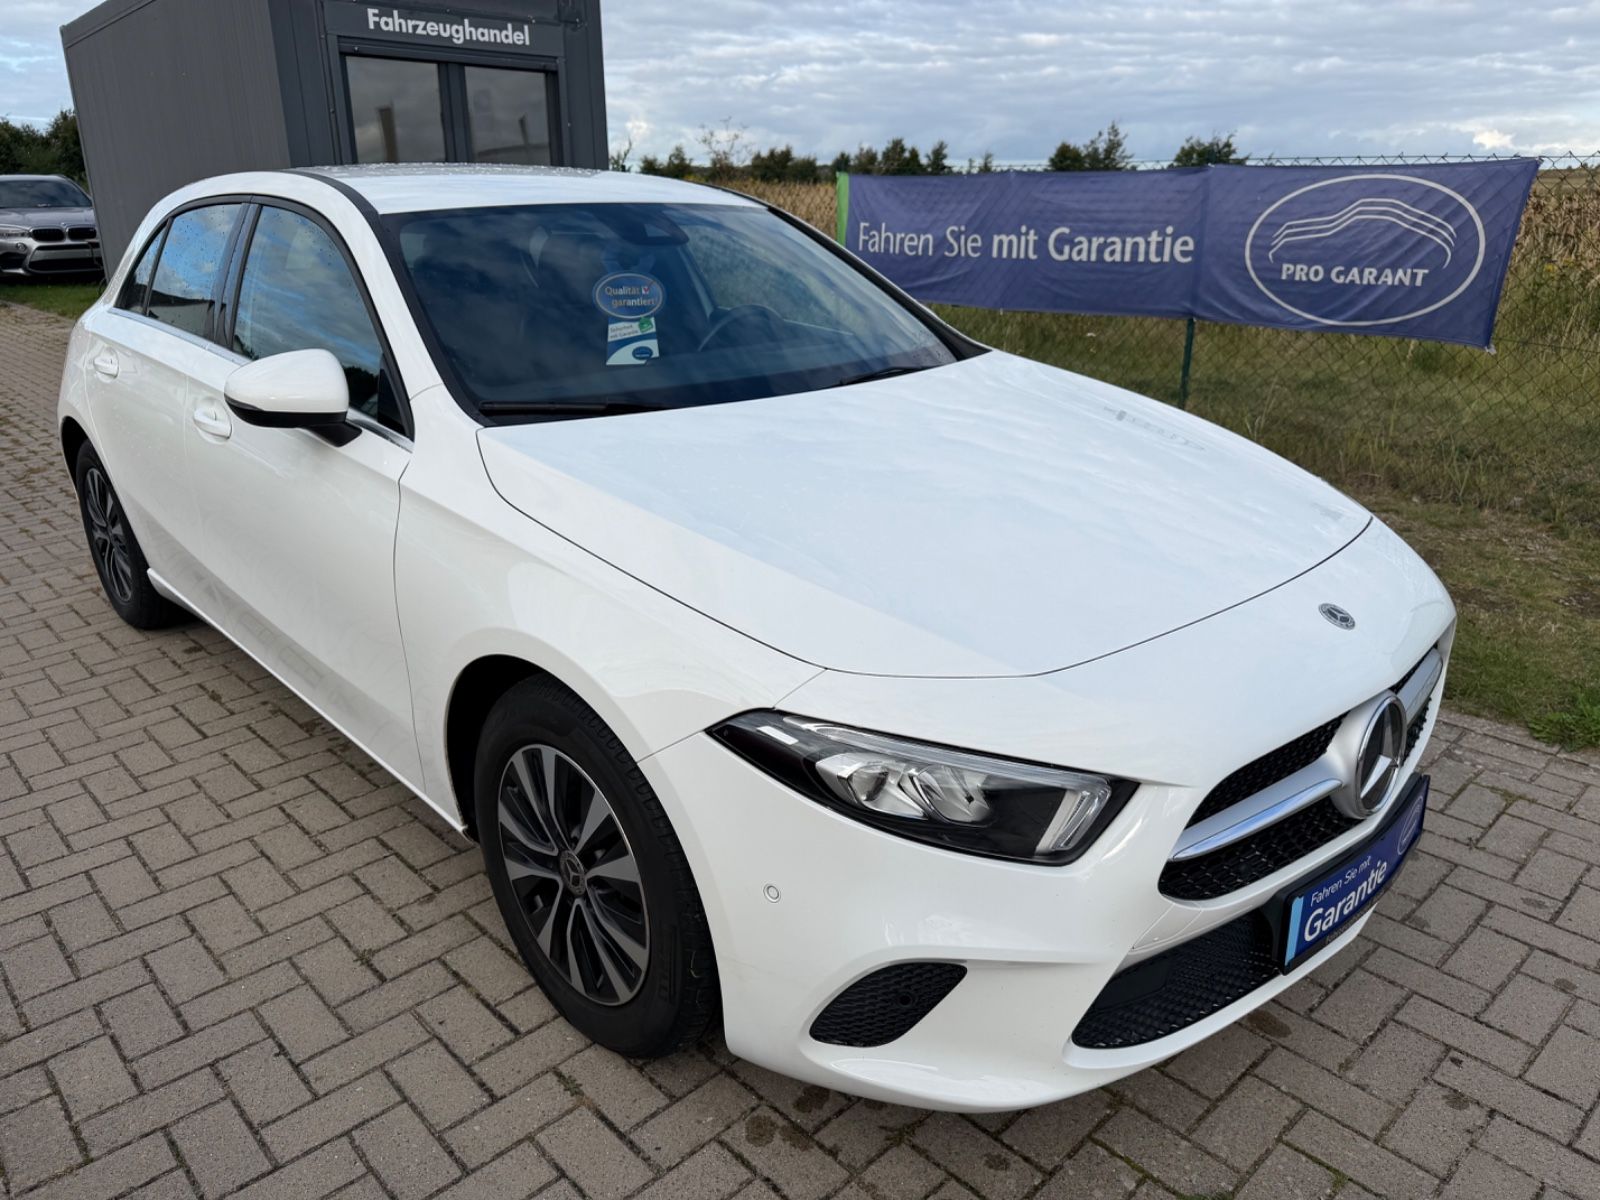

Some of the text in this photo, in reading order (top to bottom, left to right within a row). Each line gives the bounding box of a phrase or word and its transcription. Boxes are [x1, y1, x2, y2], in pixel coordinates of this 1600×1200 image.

[366, 7, 530, 46] Fahrzeughandel
[857, 221, 1195, 264] Fahren Sie mit Garantie
[1280, 263, 1430, 287] PRO GARANT
[1303, 859, 1388, 942] Garantie
[1310, 855, 1372, 908] Fahren Sie mit
